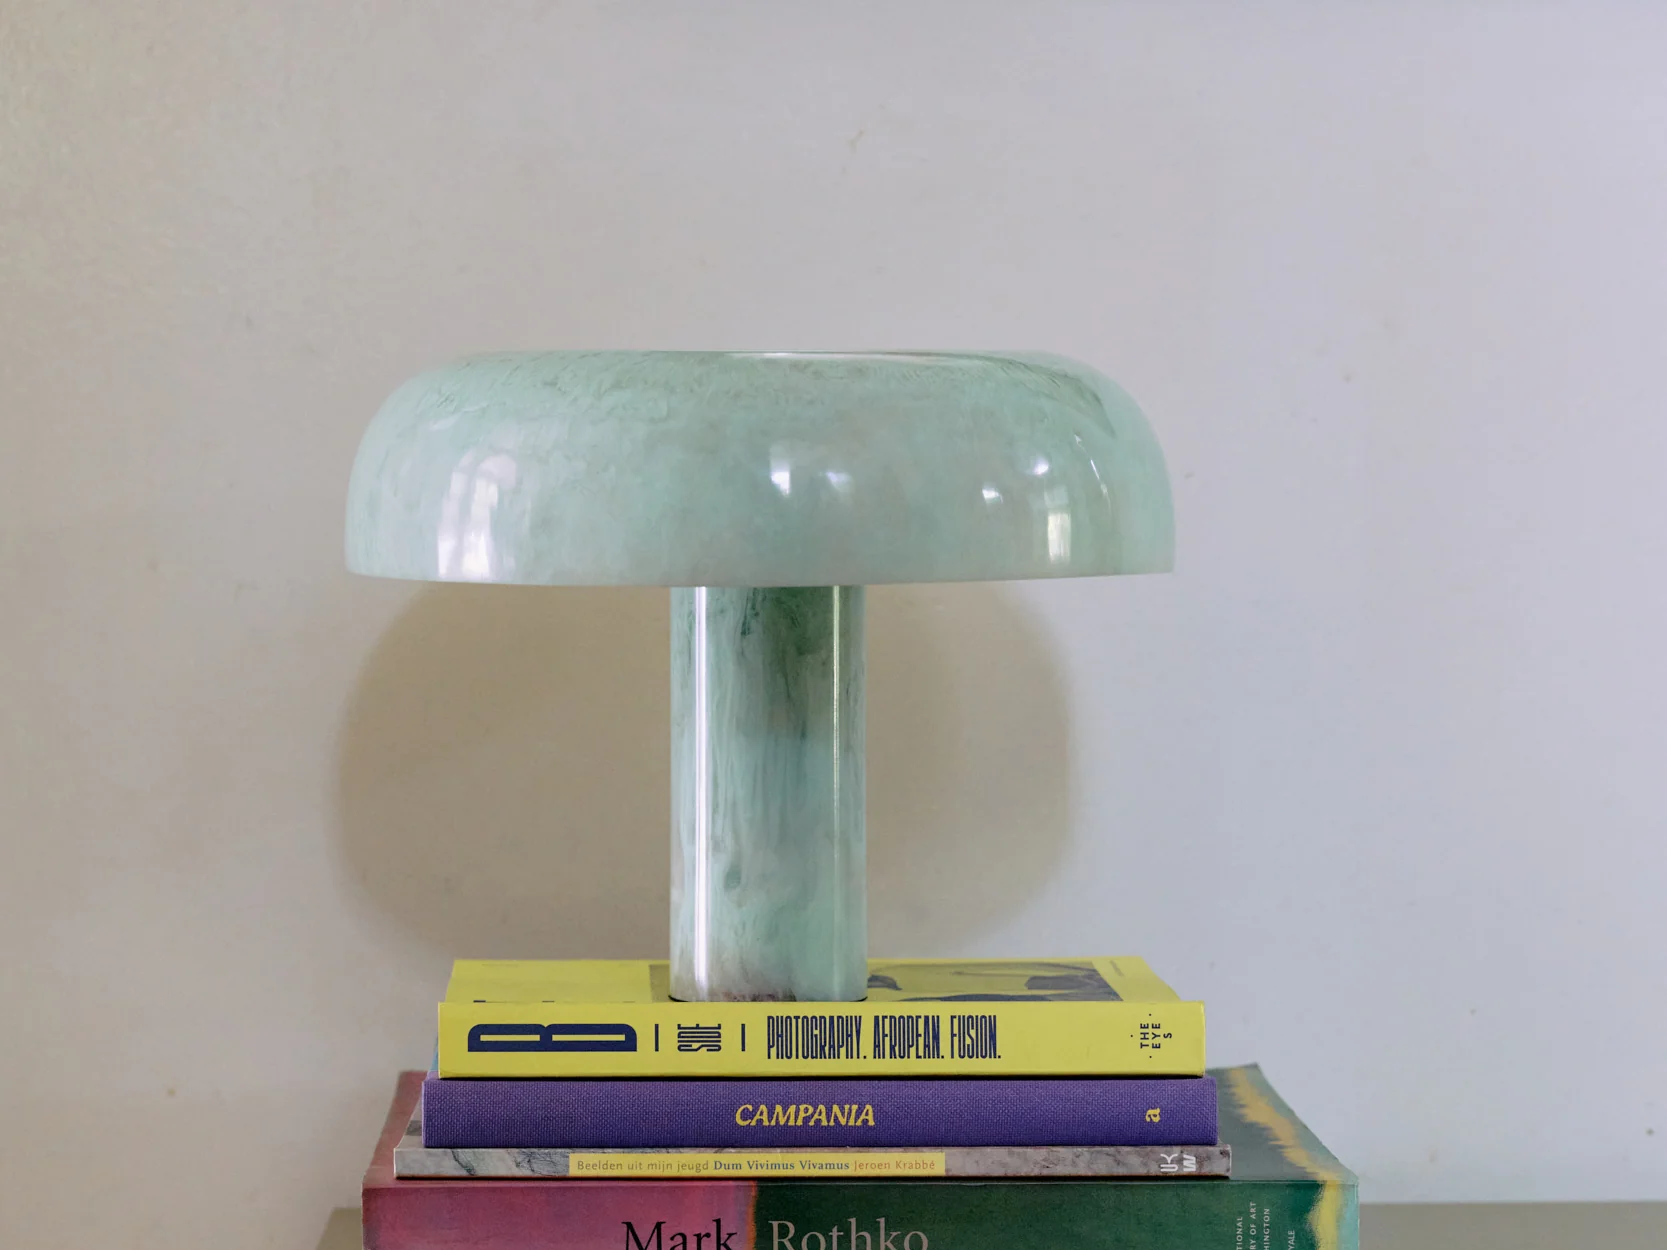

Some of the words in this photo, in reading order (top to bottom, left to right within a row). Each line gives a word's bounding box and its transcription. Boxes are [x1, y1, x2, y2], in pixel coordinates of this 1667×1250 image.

[677, 1023, 722, 1052] SIDE
[767, 1015, 867, 1060] PHOTOGRAPHY.
[873, 1015, 944, 1059] AFROPEAN.
[950, 1014, 1001, 1059] FUSION.
[1140, 1023, 1150, 1049] THE
[735, 1104, 875, 1127] CAMPANIA
[1146, 1107, 1161, 1123] a
[577, 1160, 623, 1171] Beelden
[627, 1160, 643, 1171] uit
[648, 1160, 673, 1174] mijn
[676, 1160, 709, 1174] jeugd
[713, 1160, 742, 1171] Dum
[746, 1160, 795, 1171] Vivimus
[799, 1160, 850, 1171] Vivamus
[854, 1160, 891, 1171] Jeroen
[895, 1159, 935, 1170] Krabbé
[1250, 1222, 1257, 1236] OF
[1288, 1230, 1296, 1250] YALE
